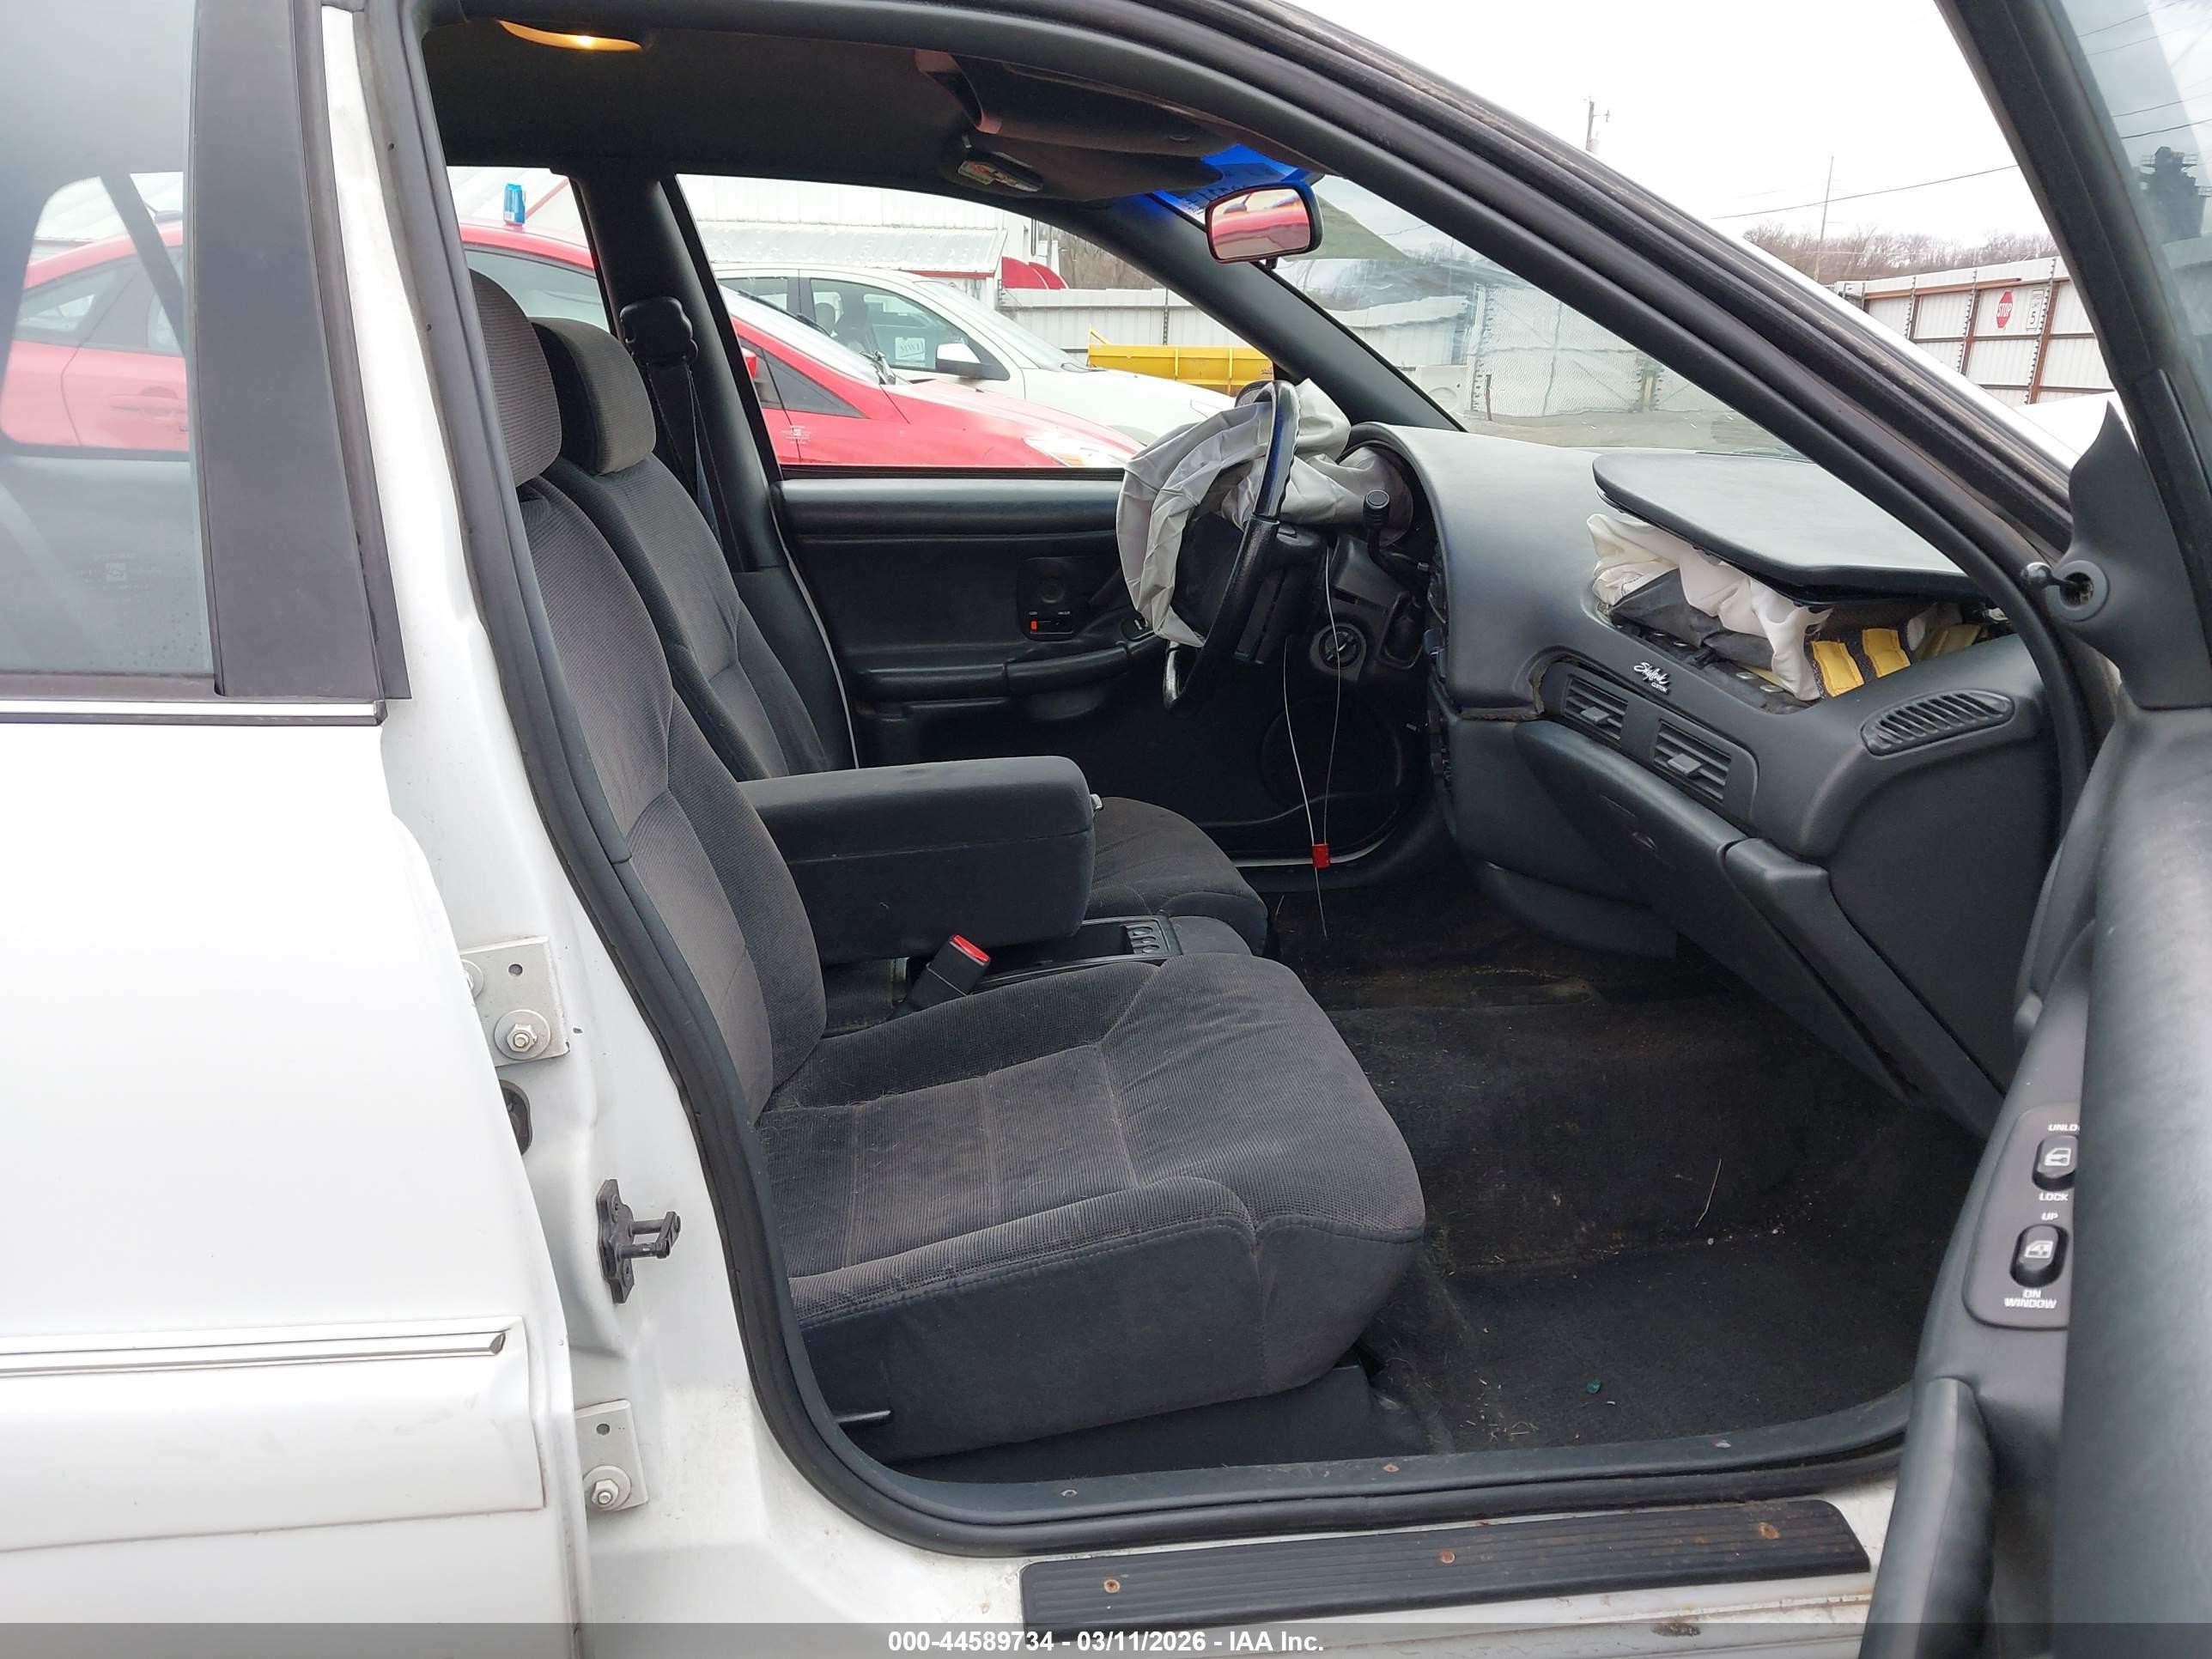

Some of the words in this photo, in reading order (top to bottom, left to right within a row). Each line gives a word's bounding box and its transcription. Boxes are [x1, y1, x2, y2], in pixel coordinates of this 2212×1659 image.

[1996, 302, 2013, 317] STOP
[2029, 311, 2036, 325] 5
[2047, 1123, 2080, 1132] UNLO
[2039, 1192, 2069, 1201] LOCK
[2041, 1212, 2058, 1221] UP
[2003, 1297, 2057, 1309] WINDOW
